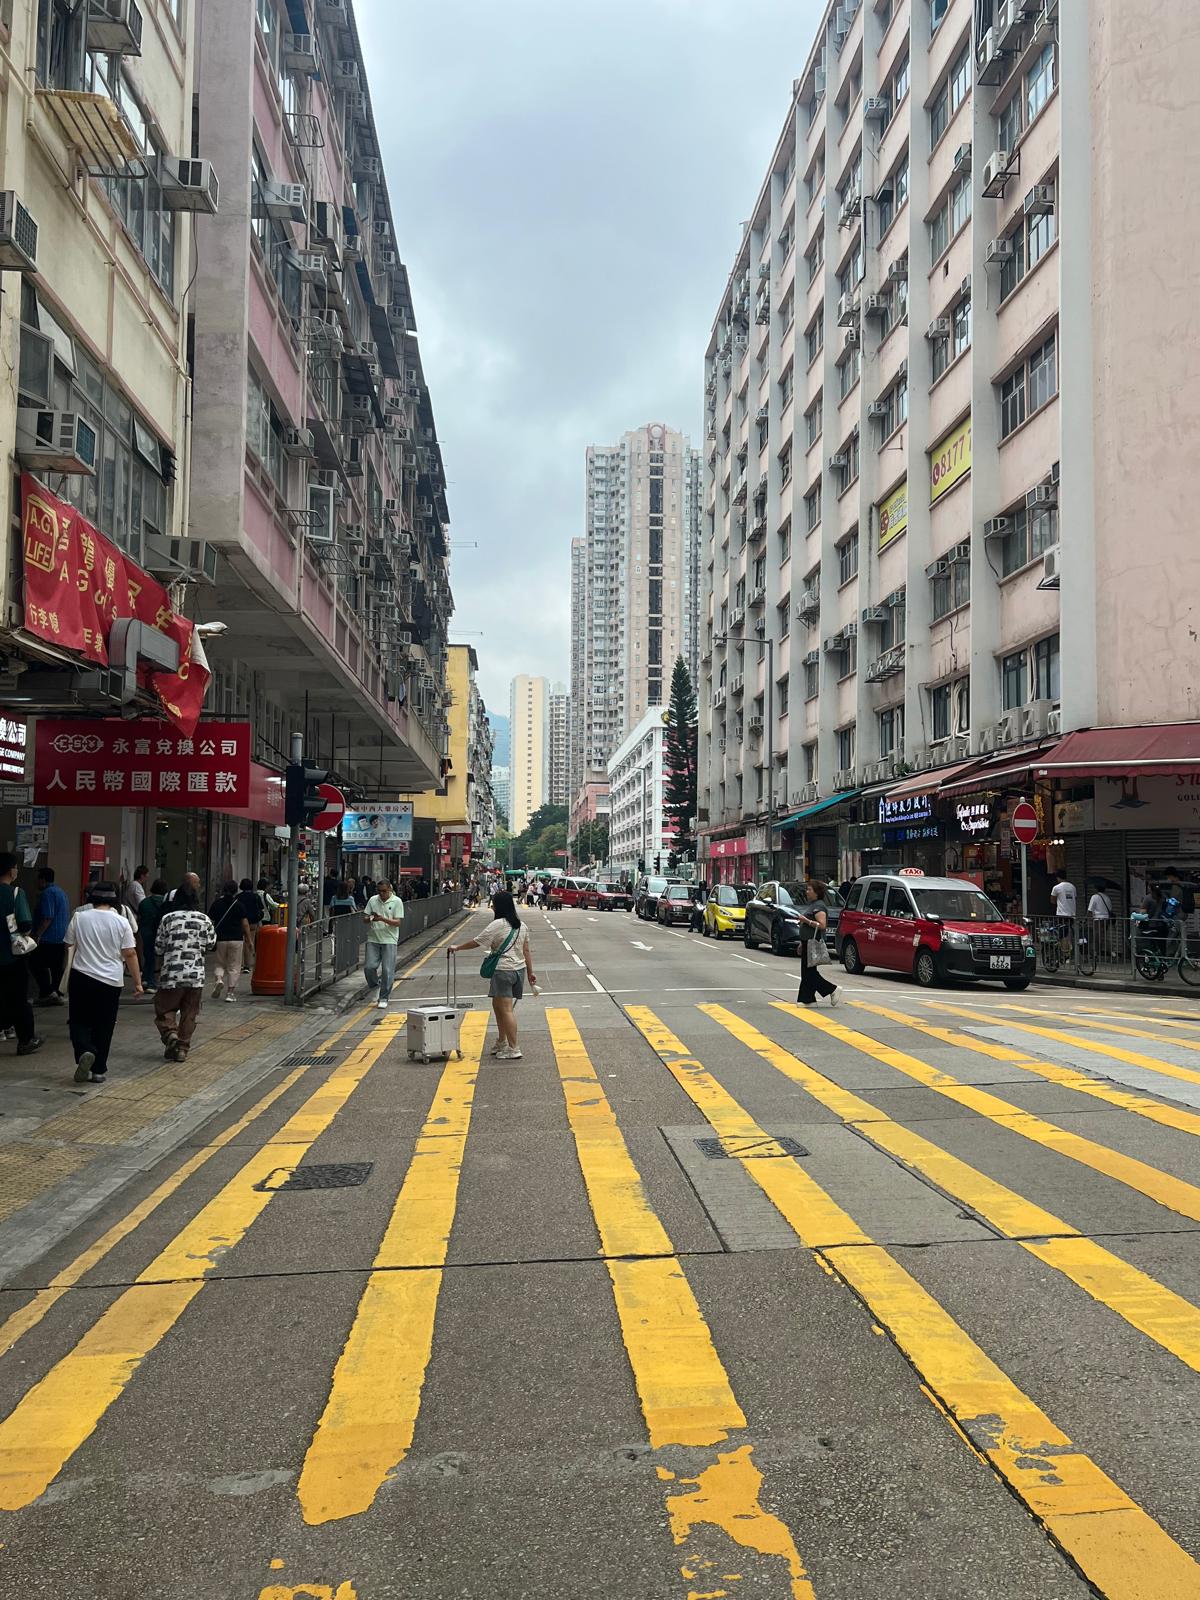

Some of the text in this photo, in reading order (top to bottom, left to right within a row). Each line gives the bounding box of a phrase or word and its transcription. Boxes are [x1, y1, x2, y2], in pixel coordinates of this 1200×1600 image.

[27, 537, 52, 567] LIFE
[46, 769, 237, 793] 人民幣國際匯款
